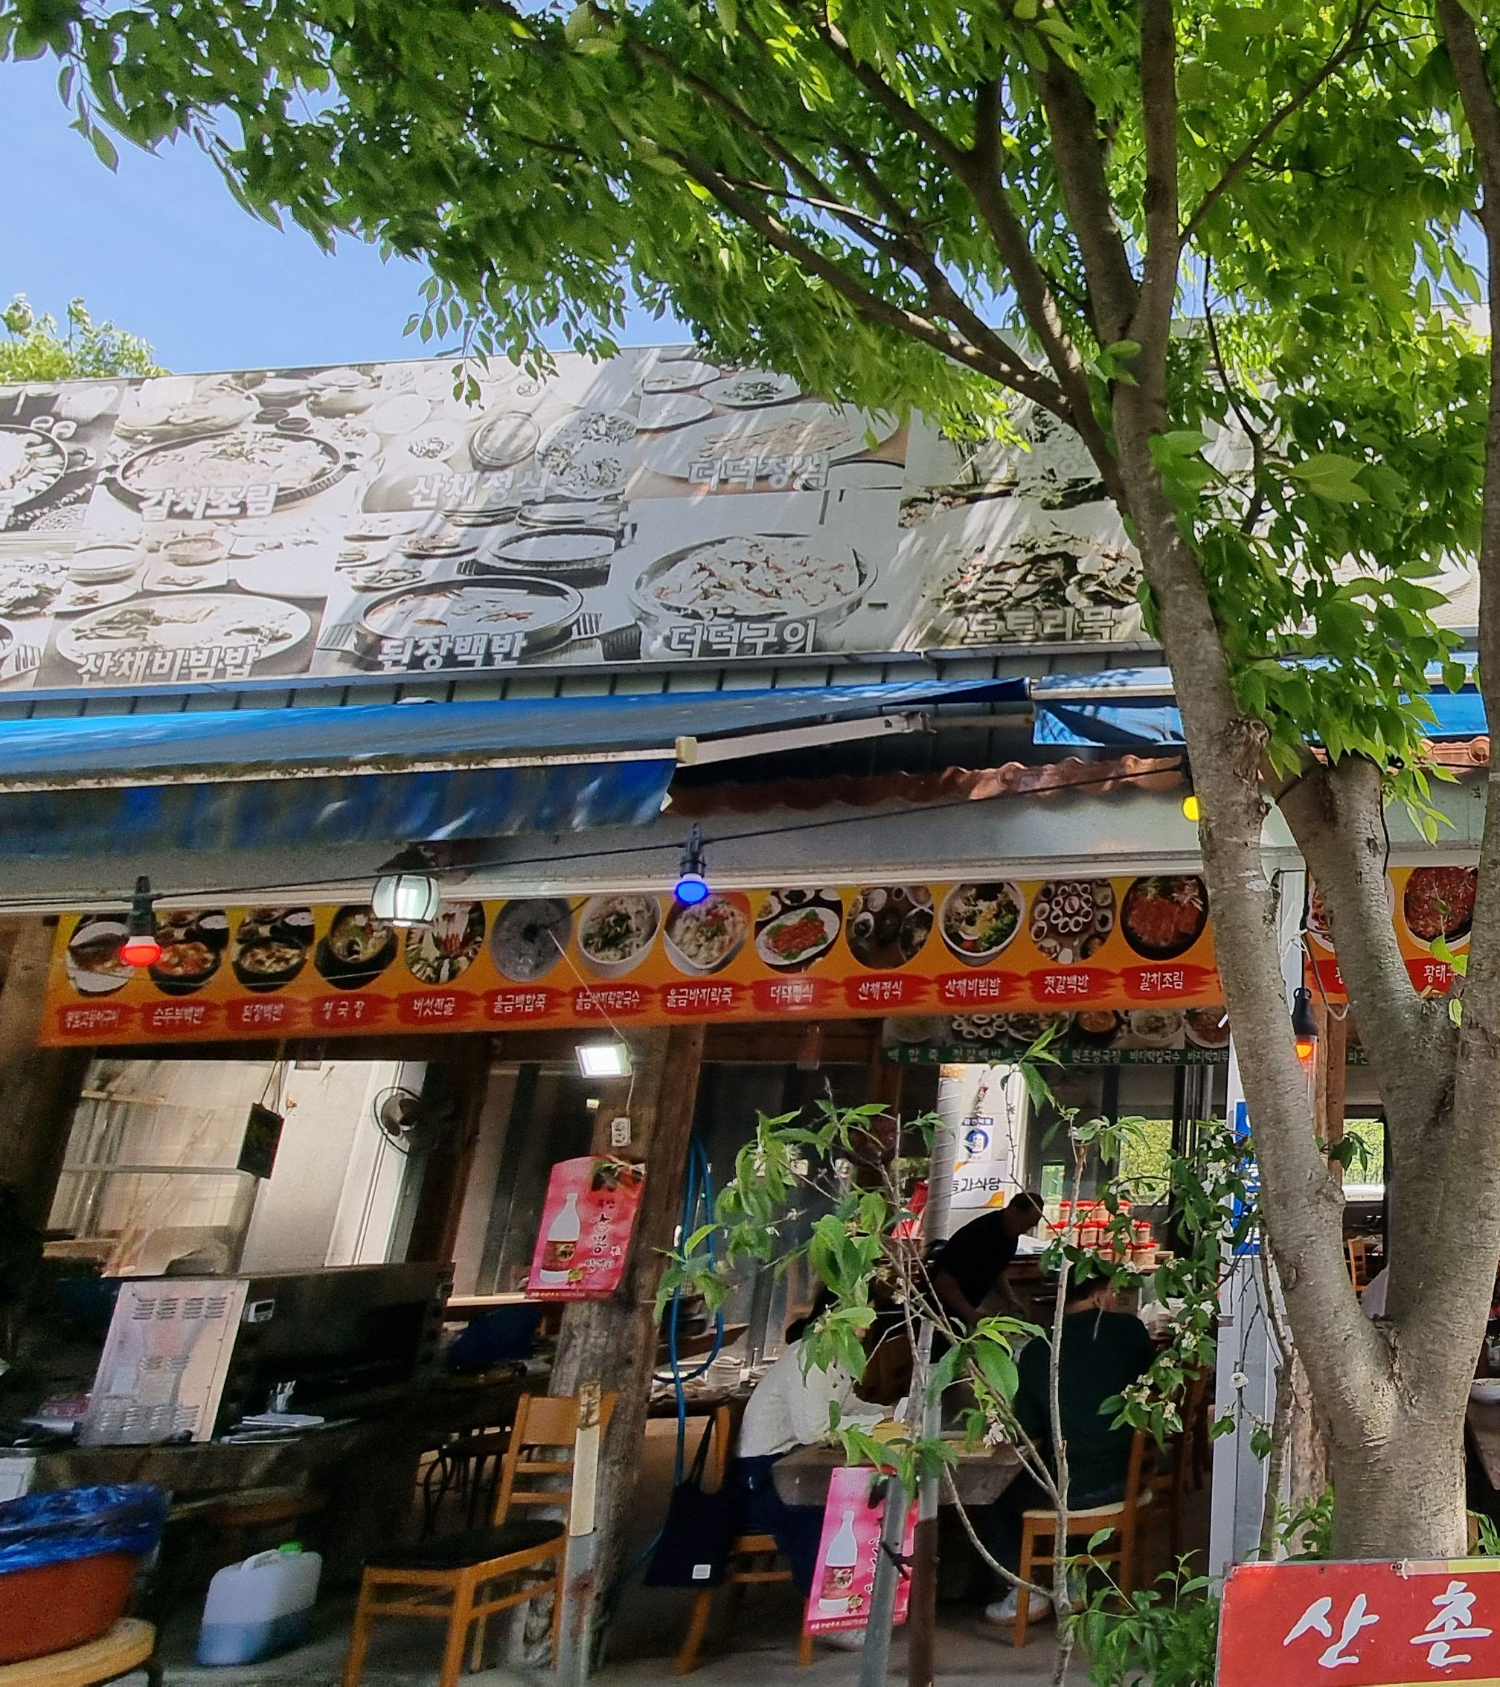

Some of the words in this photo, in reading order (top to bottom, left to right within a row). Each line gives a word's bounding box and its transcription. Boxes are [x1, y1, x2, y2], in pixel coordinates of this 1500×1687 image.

[688, 453, 831, 490] 더덕정식
[409, 468, 553, 506] 산채정식
[139, 482, 278, 521] 갈치조림
[962, 604, 1117, 645] 도토리묵
[669, 620, 817, 658] 더덕구이
[378, 632, 528, 671] 된장백반
[77, 643, 262, 684] 산채비빔밥
[858, 980, 903, 1001] 산채정식
[944, 977, 1000, 998] 산채비빔밥
[1044, 974, 1089, 994] 젓갈백반
[1139, 971, 1184, 992] 갈치조림
[412, 996, 456, 1018] 버섯전골
[666, 986, 733, 1008] 울금바지락죽
[242, 1002, 284, 1022] 된장백반
[322, 1000, 365, 1020] 청국장
[1130, 1048, 1181, 1064] 바지락칼국수
